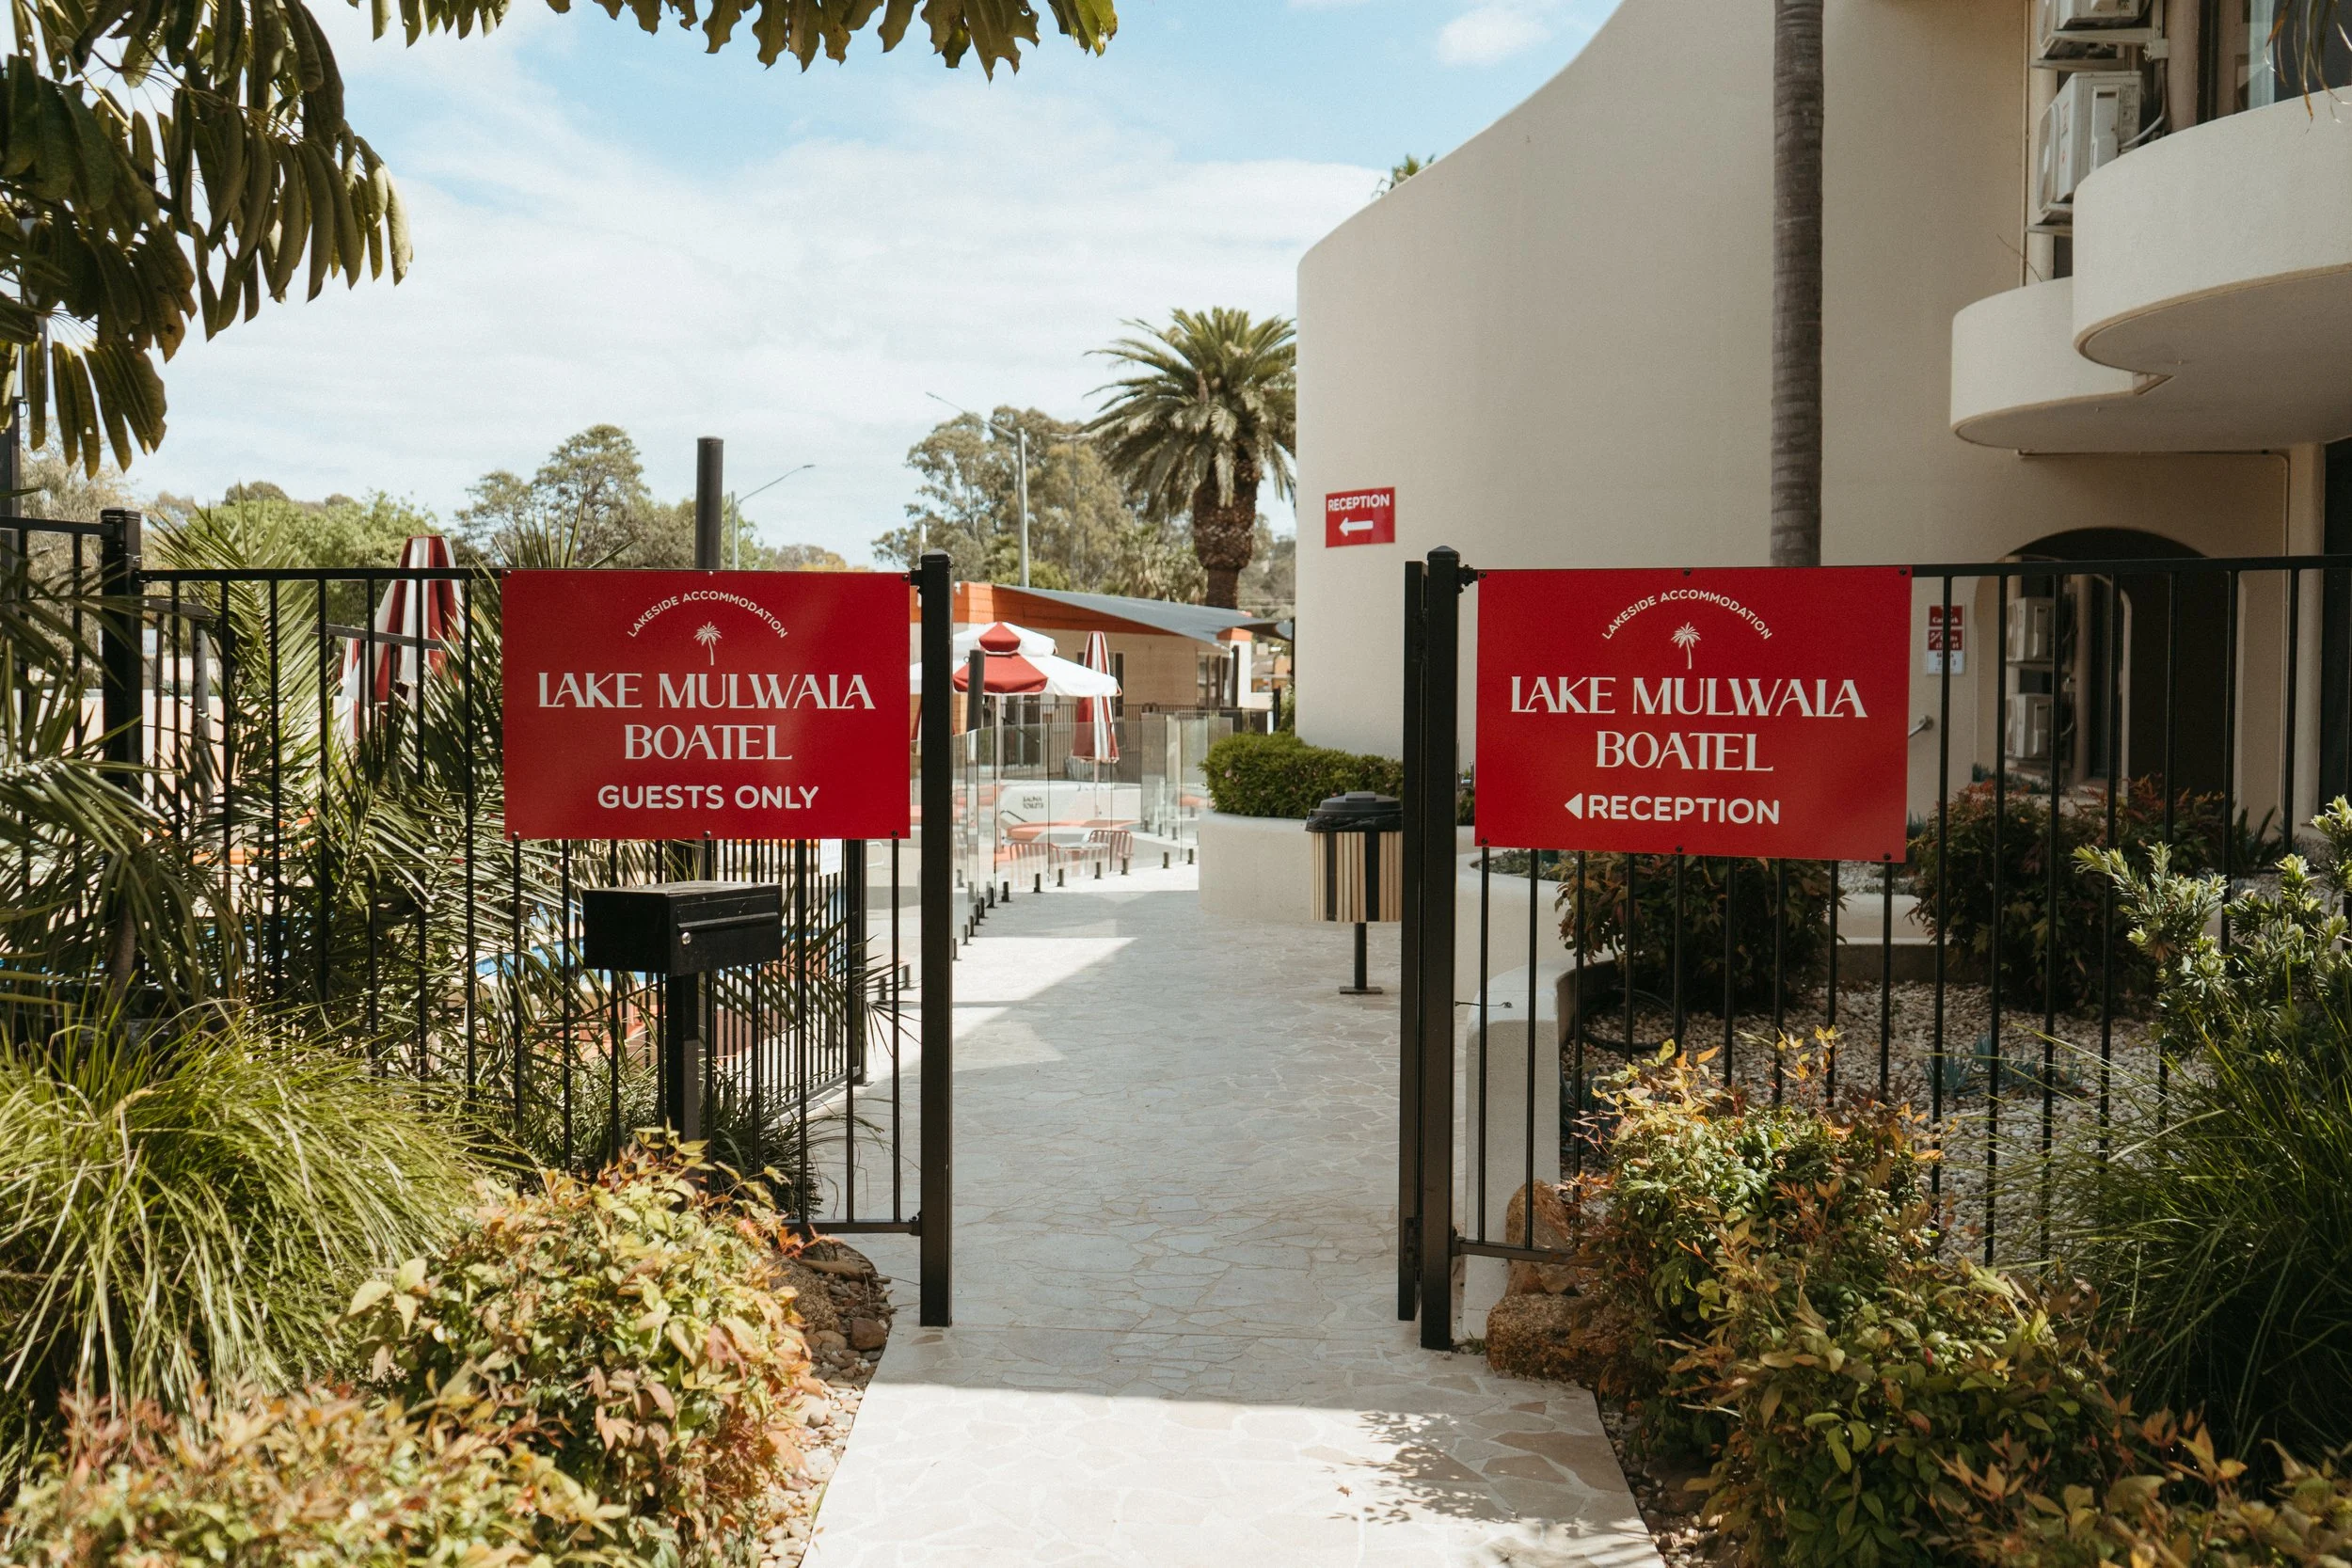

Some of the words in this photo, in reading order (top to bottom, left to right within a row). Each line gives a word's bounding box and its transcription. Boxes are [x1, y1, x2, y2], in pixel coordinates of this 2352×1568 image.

[1327, 494, 1391, 512] RECEPTION
[627, 595, 679, 638] LAKESIDE
[682, 590, 788, 639] ACCOMMODATION
[1602, 595, 1657, 640] LAKESIDE
[1660, 589, 1772, 640] ACCOMMODATION
[538, 672, 643, 708] LAKE
[659, 673, 876, 709] MULWALA
[1511, 675, 1616, 714] LAKE
[1632, 677, 1868, 718] MULWALA
[624, 724, 793, 760] BOATEL
[1596, 730, 1774, 772] BOATEL
[597, 784, 725, 810] GUESTS
[735, 784, 819, 810] ONLY
[1588, 794, 1780, 825] RECEPTION
